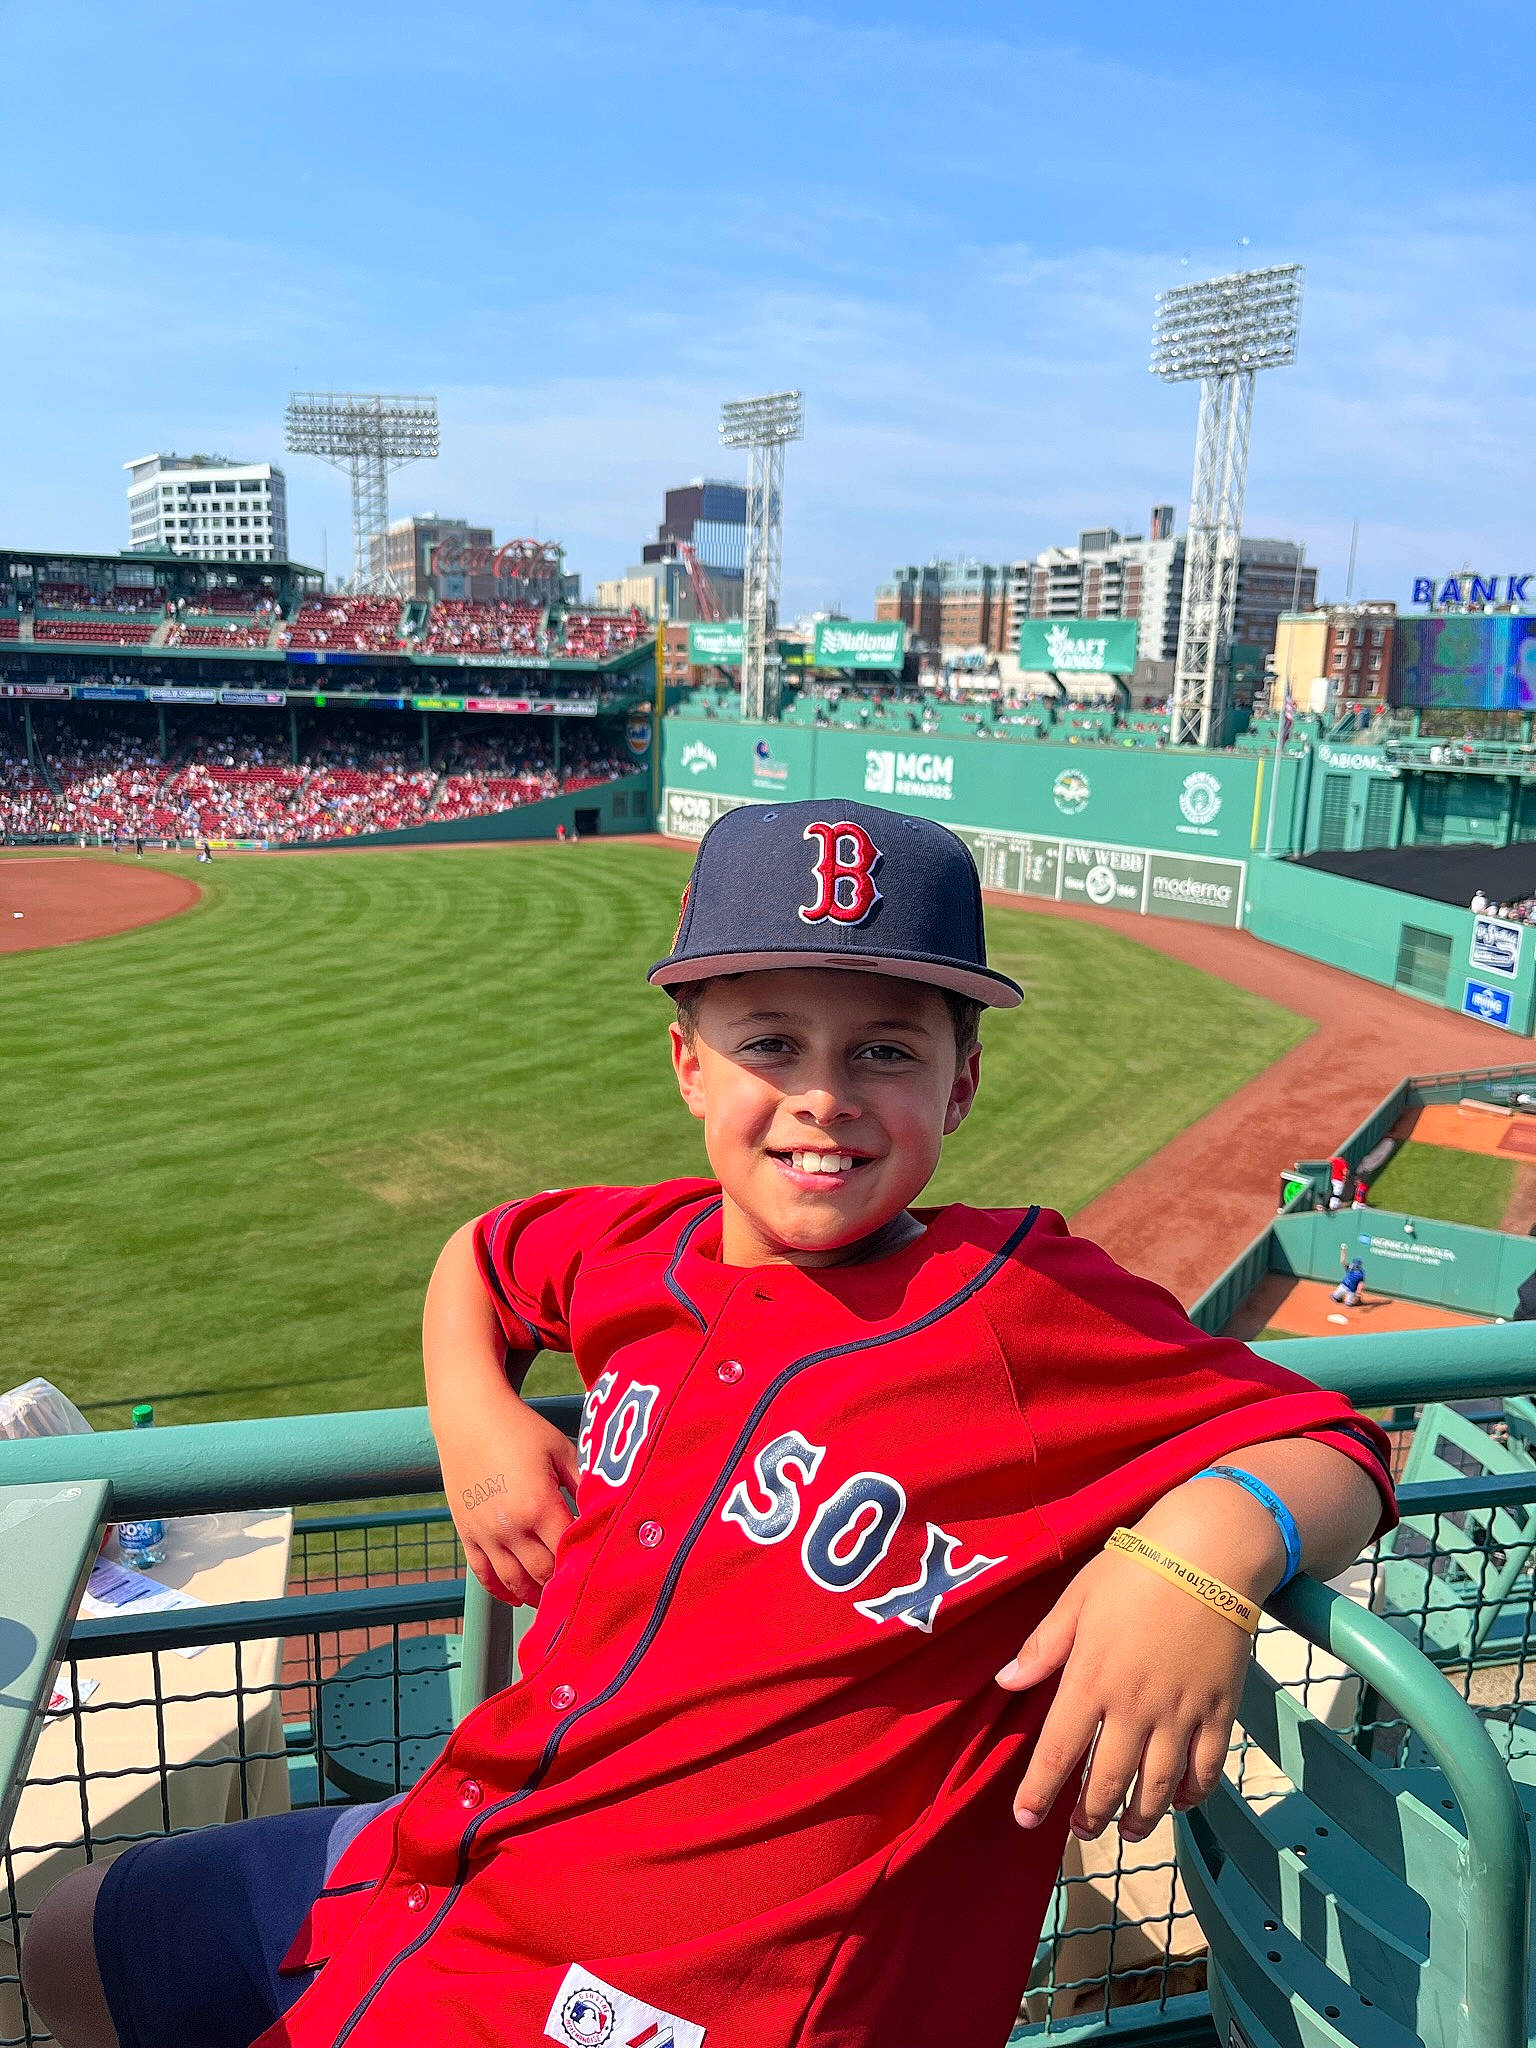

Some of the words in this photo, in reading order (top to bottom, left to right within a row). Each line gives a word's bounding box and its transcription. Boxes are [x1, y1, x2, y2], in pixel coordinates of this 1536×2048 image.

[1411, 575, 1534, 603] BANK
[895, 752, 955, 784] MGM
[894, 779, 953, 800] REWARDS
[799, 820, 884, 926] B
[1094, 848, 1144, 873] WEBB
[1152, 876, 1233, 901] moderna
[462, 1473, 508, 1510] SAM
[577, 1369, 660, 1488] ED
[721, 1430, 1008, 1633] SOX
[119, 1522, 153, 1536] 00%
[1137, 1543, 1161, 1562] WITH
[1160, 1557, 1188, 1577] PLAY
[1186, 1572, 1201, 1586] TO
[1196, 1578, 1239, 1611] COOL
[1235, 1603, 1252, 1620] TOO
[579, 1993, 610, 2013] GENUINE
[565, 2019, 602, 2044] MERCHANDISE
